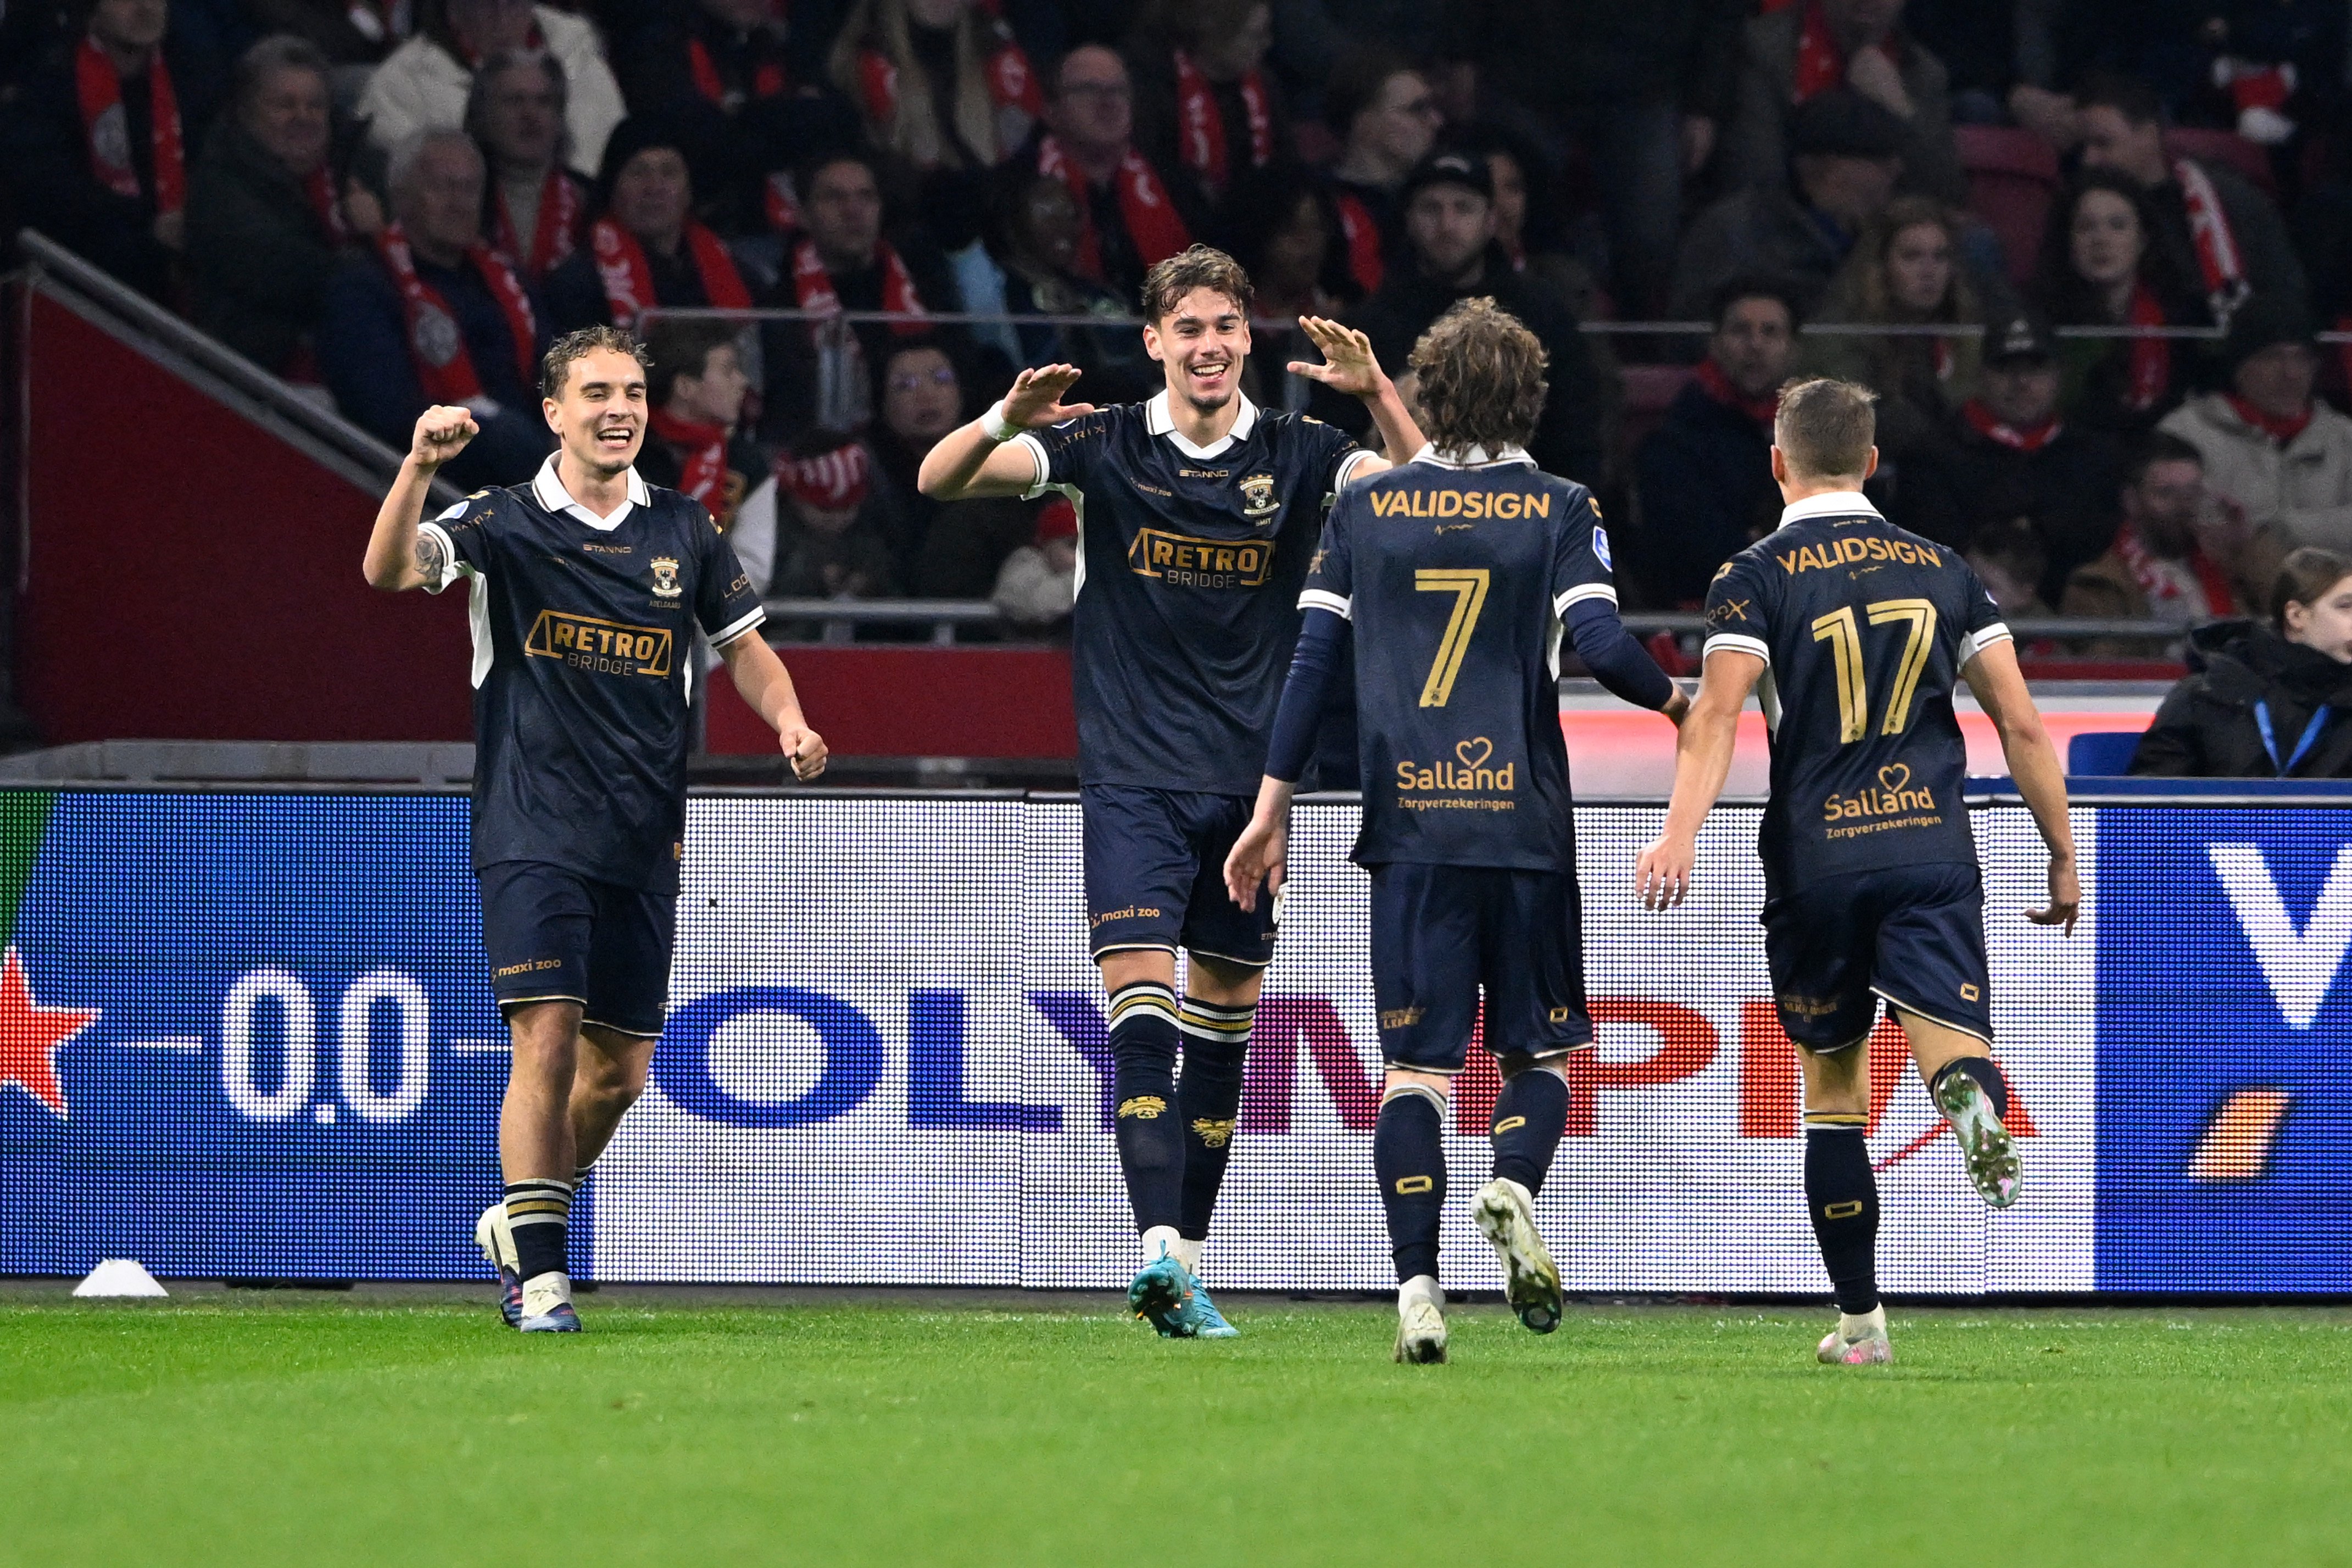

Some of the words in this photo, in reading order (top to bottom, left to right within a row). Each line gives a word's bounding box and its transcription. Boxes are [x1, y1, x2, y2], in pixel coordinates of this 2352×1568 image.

[1179, 470, 1229, 478] STANNO
[1138, 483, 1157, 493] maxi
[1370, 490, 1550, 519] VALIDSIGN
[583, 544, 632, 554] STANNO
[1153, 540, 1258, 572] RETRO
[1776, 537, 1942, 576] VALIDSIGN
[1167, 570, 1235, 588] BRIDGE
[554, 622, 655, 660] RETRO
[1414, 568, 1490, 708] 7
[567, 652, 633, 676] BRIDGE
[1812, 598, 1937, 744] 17
[1397, 761, 1514, 790] Salland
[1398, 797, 1515, 811] Zorgverzekeringen
[1824, 786, 1936, 821] Salland
[1825, 816, 1942, 839] Zorgverzekeringen
[1101, 905, 1134, 922] maxi
[1137, 908, 1160, 918] zoo
[498, 958, 533, 976] maxi
[536, 959, 561, 970] zoo
[221, 965, 430, 1124] 0.0
